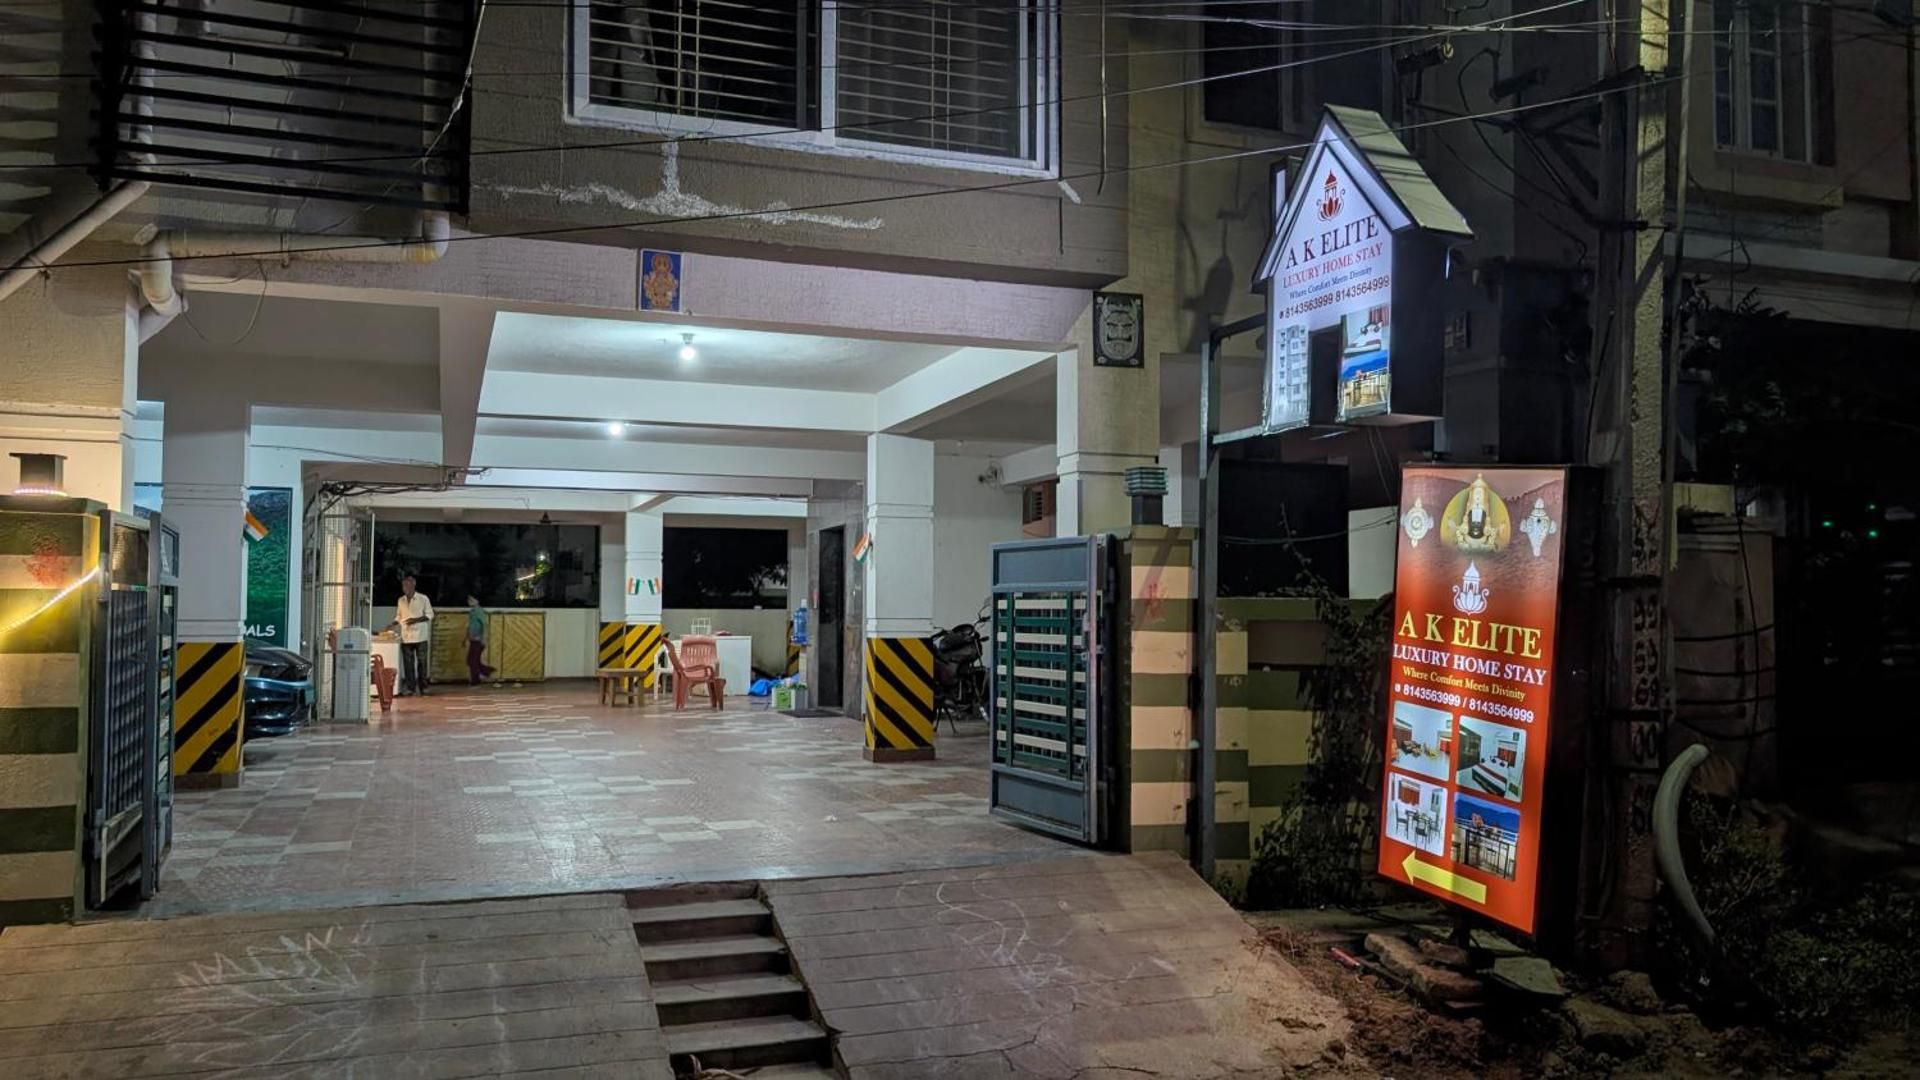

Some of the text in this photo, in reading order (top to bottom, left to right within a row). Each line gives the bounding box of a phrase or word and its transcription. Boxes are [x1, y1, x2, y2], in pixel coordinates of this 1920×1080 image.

[1286, 214, 1379, 269] A K ELITE
[1283, 243, 1383, 288] LUXURY HOME STAY
[1286, 275, 1390, 319] 8143563999 8143564999
[1398, 610, 1542, 659] A K ELITE
[1392, 643, 1547, 686] LUXURY HOME STAY
[1402, 665, 1526, 702] Where Comfort Meets Divinity
[1403, 683, 1461, 707] 8143563999
[1469, 698, 1534, 723] 8143564999
